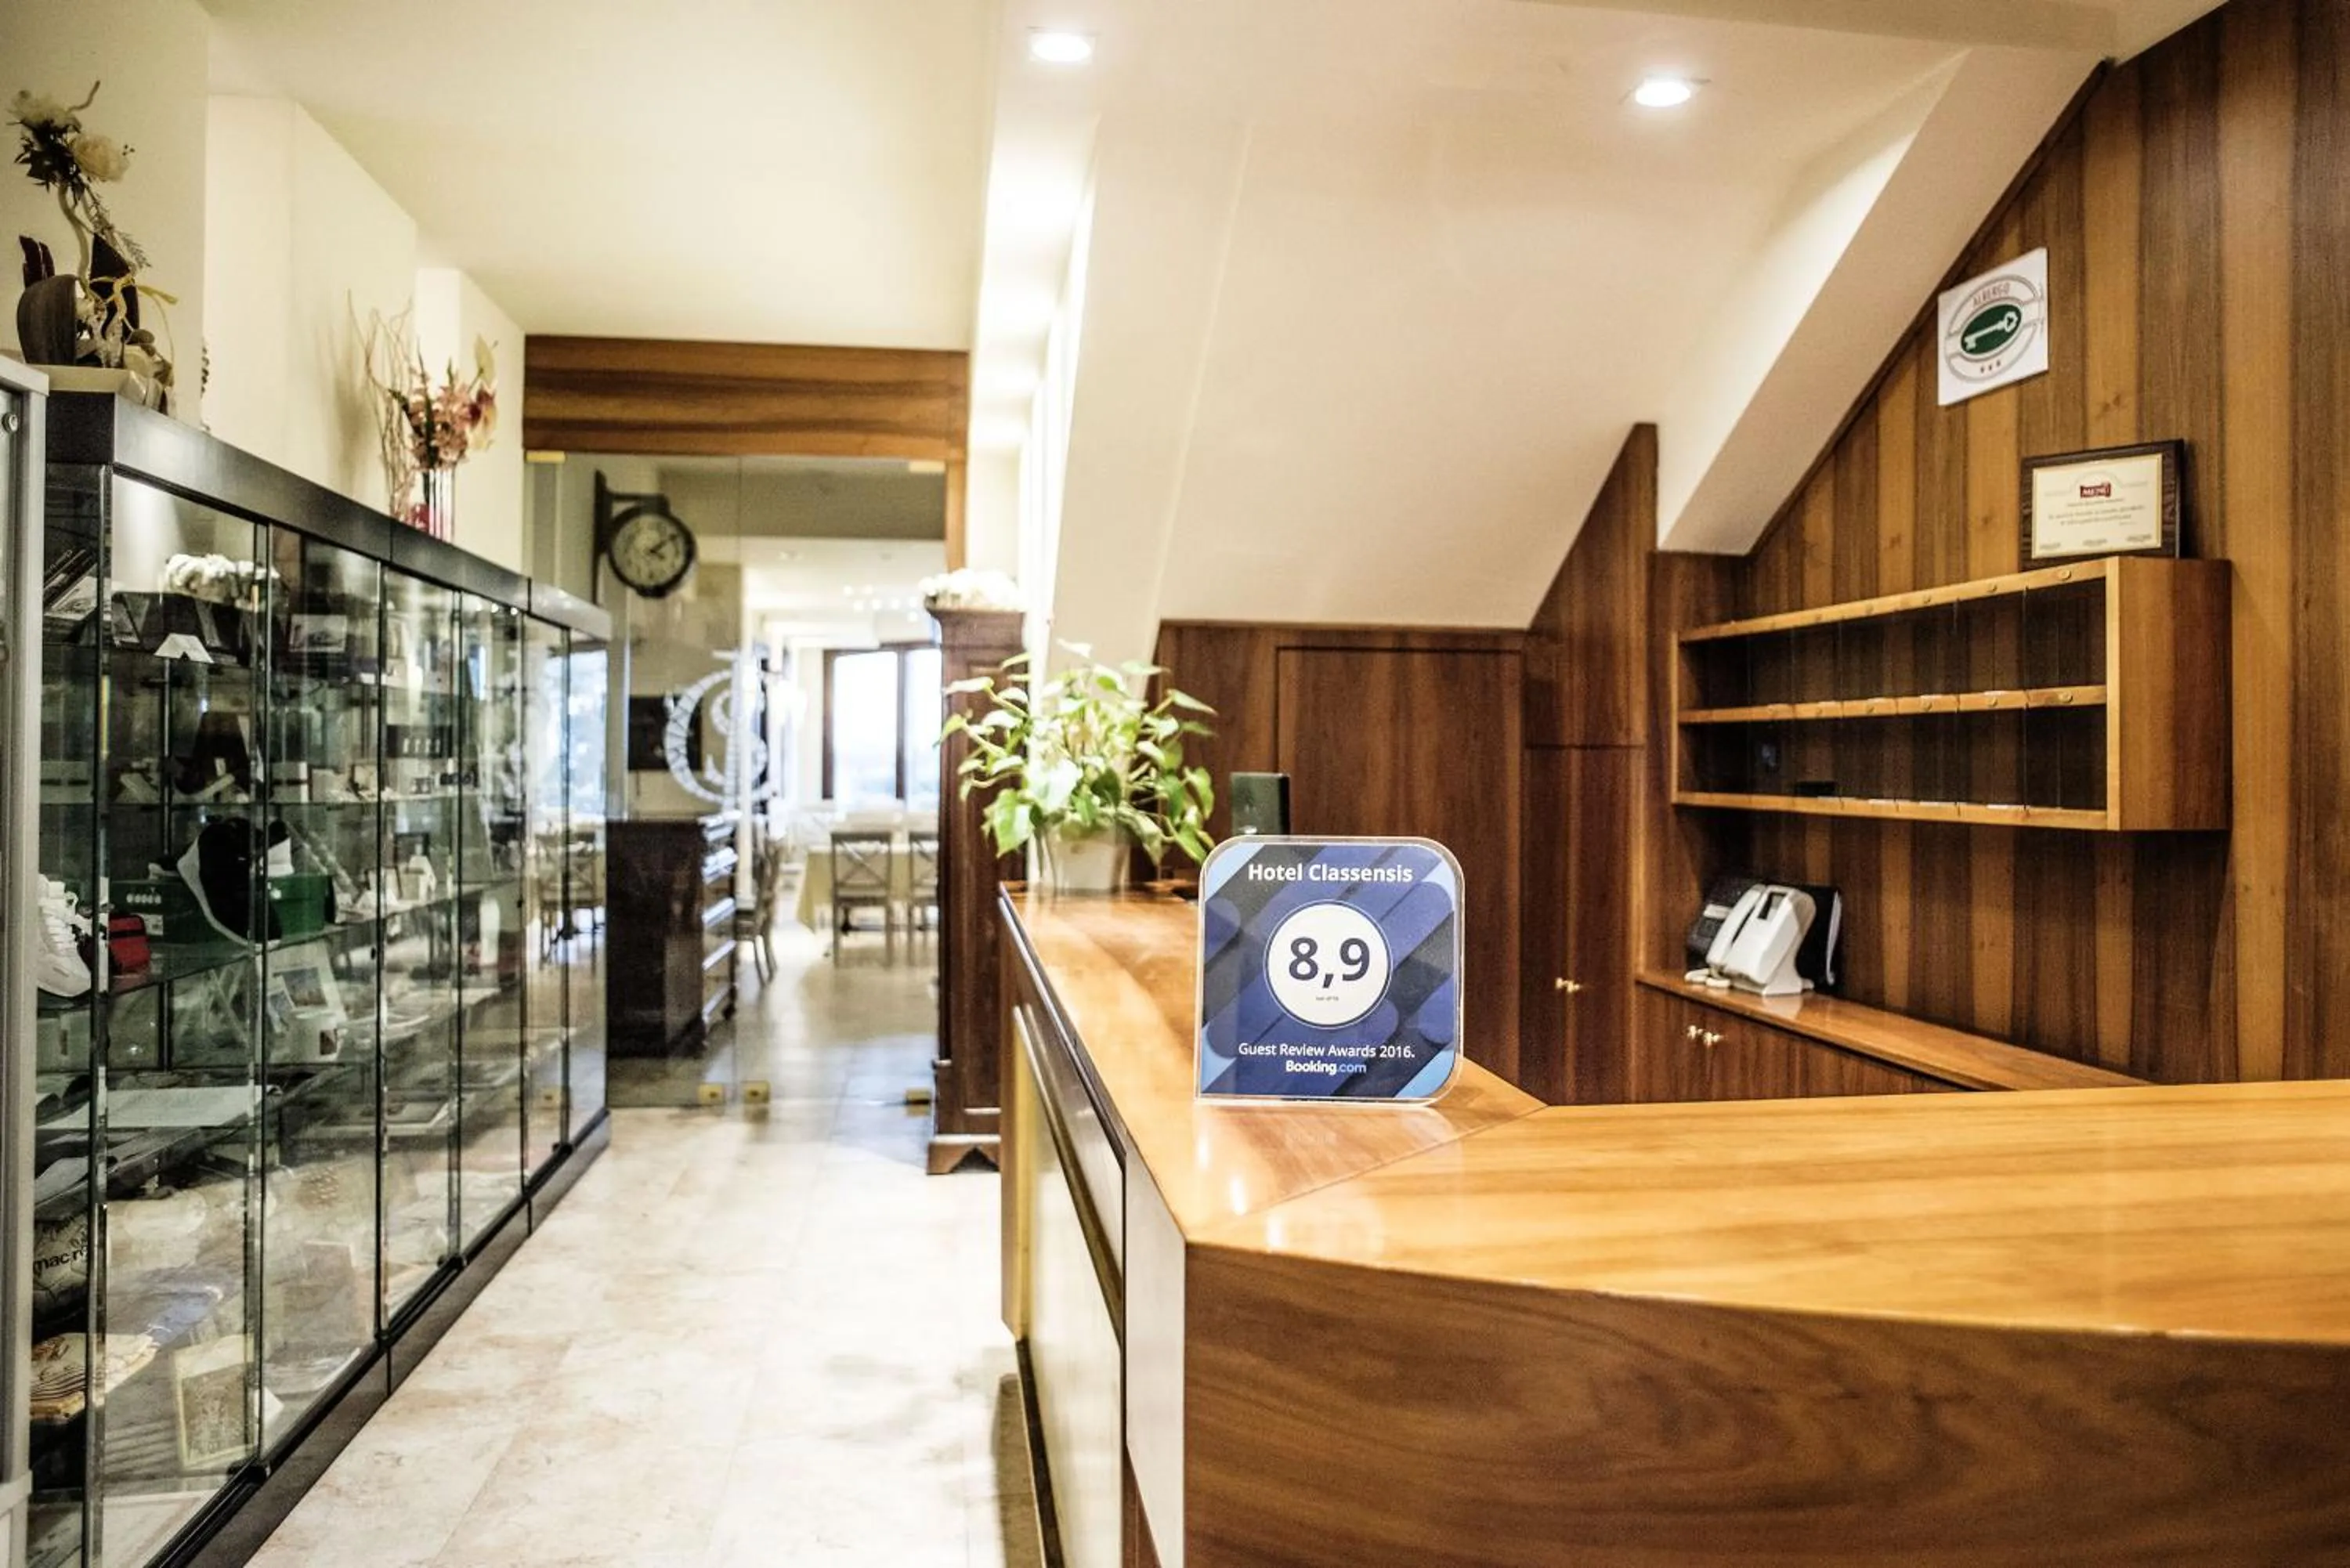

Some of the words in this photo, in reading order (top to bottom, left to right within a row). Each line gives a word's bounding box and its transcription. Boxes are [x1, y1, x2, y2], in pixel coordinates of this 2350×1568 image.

[1248, 863, 1303, 881] Hotel
[1308, 864, 1413, 882] Classensis
[1289, 937, 1370, 988] 8,9
[1238, 1042, 1276, 1055] Guest
[1279, 1043, 1324, 1057] Review
[1328, 1045, 1376, 1058] Awards
[1285, 1060, 1367, 1075] Booking.com
